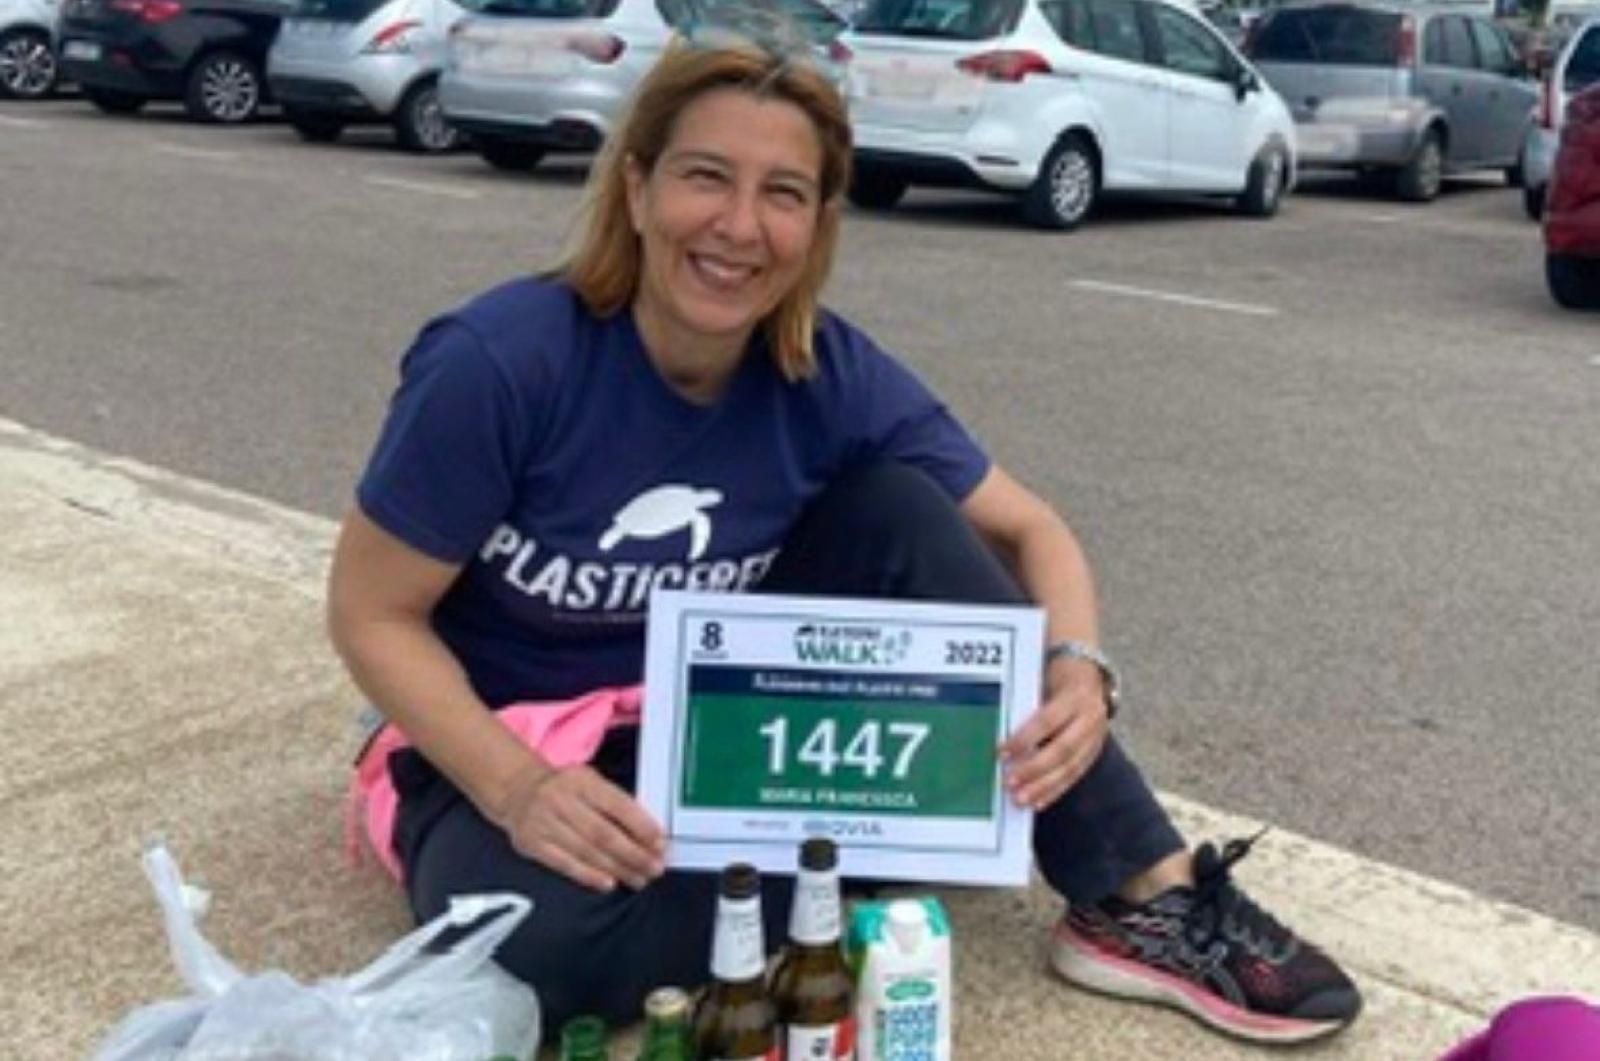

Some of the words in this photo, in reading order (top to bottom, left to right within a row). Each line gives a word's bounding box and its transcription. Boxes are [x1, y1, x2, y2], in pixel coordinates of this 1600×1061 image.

[702, 621, 722, 650] 8
[795, 638, 878, 664] WALK
[945, 640, 1003, 665] 2022
[759, 716, 931, 780] 1447
[759, 786, 813, 804] MARIA
